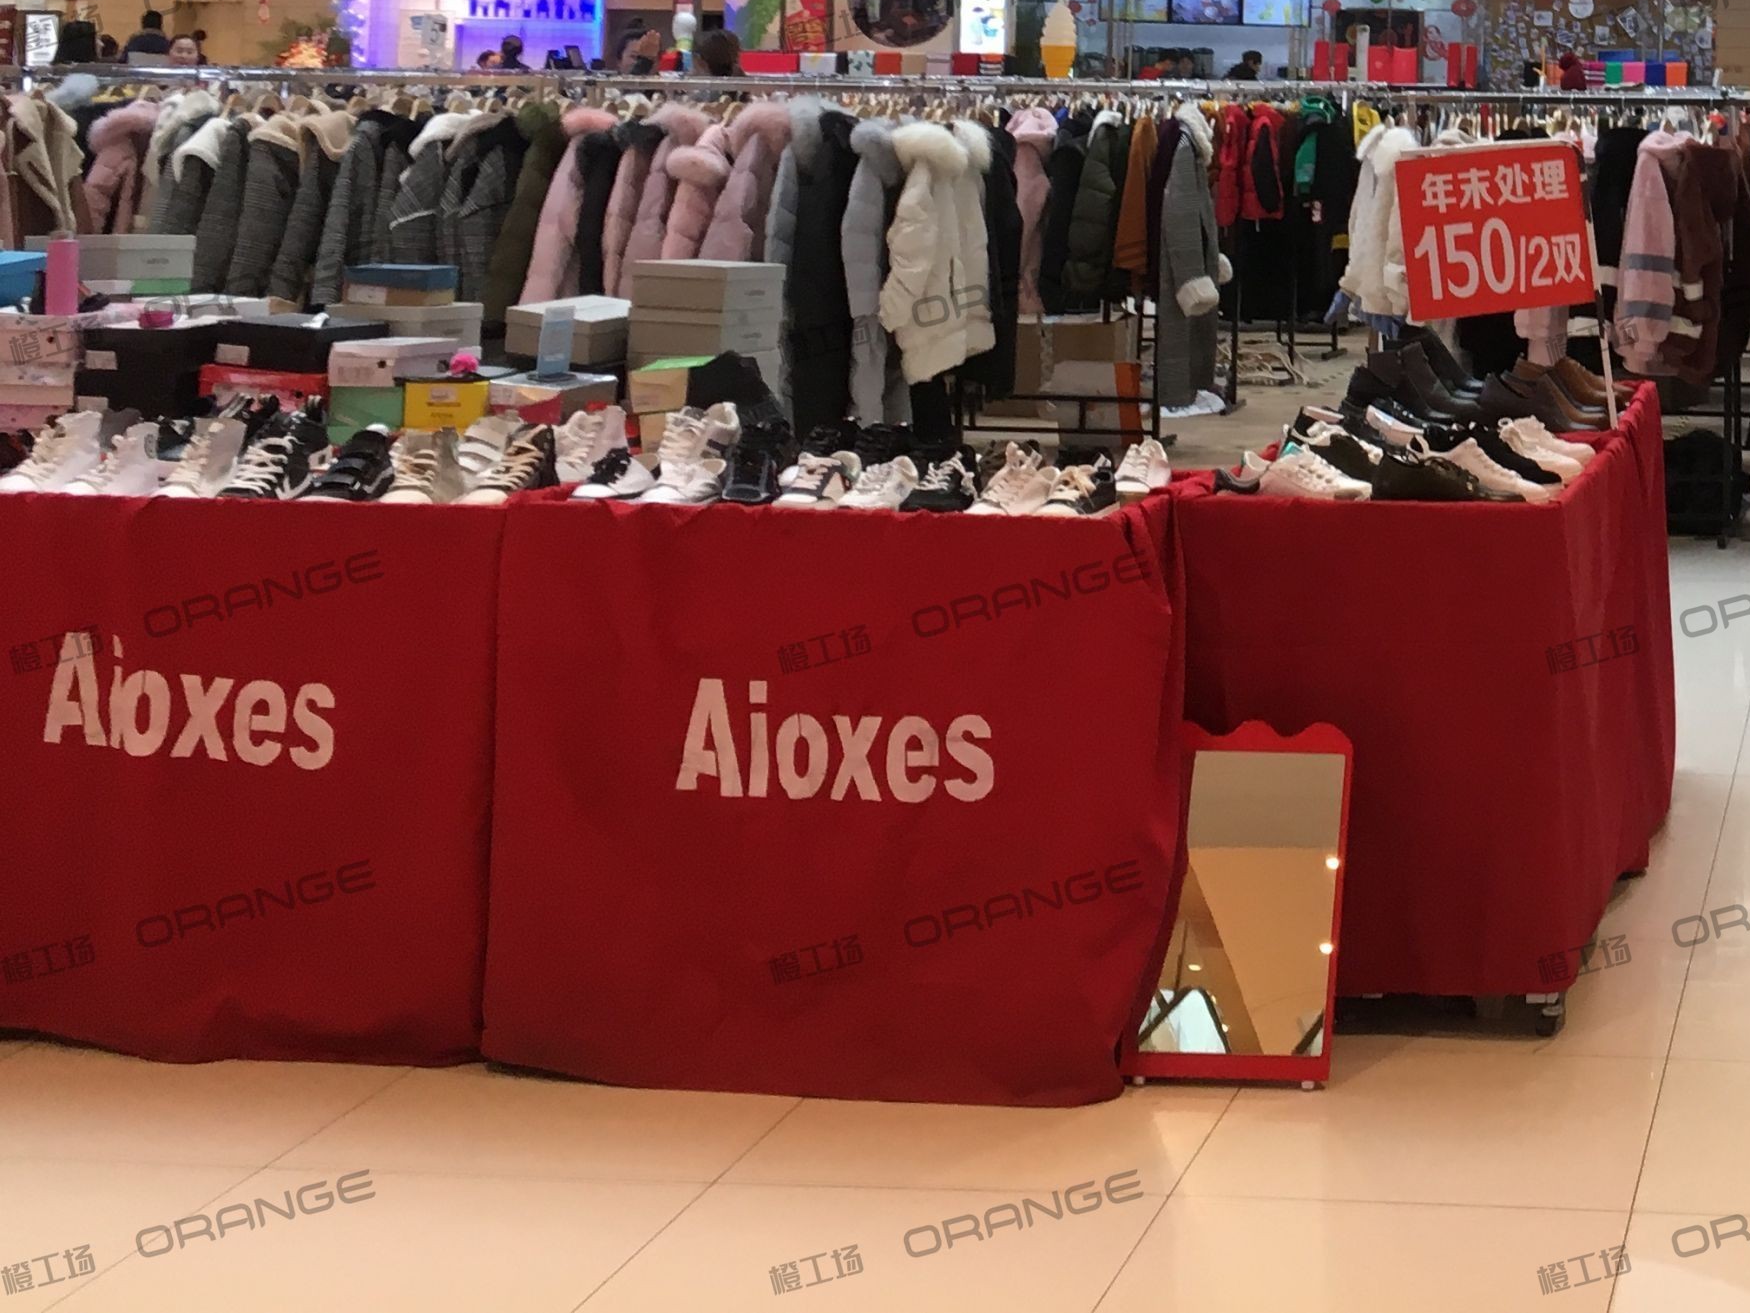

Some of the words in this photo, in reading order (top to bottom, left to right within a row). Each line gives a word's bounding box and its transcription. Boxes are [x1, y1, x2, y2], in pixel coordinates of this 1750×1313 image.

[1420, 159, 1569, 214] 年末处理
[43, 631, 336, 771] Aioxes
[676, 678, 996, 803] Aioxes
